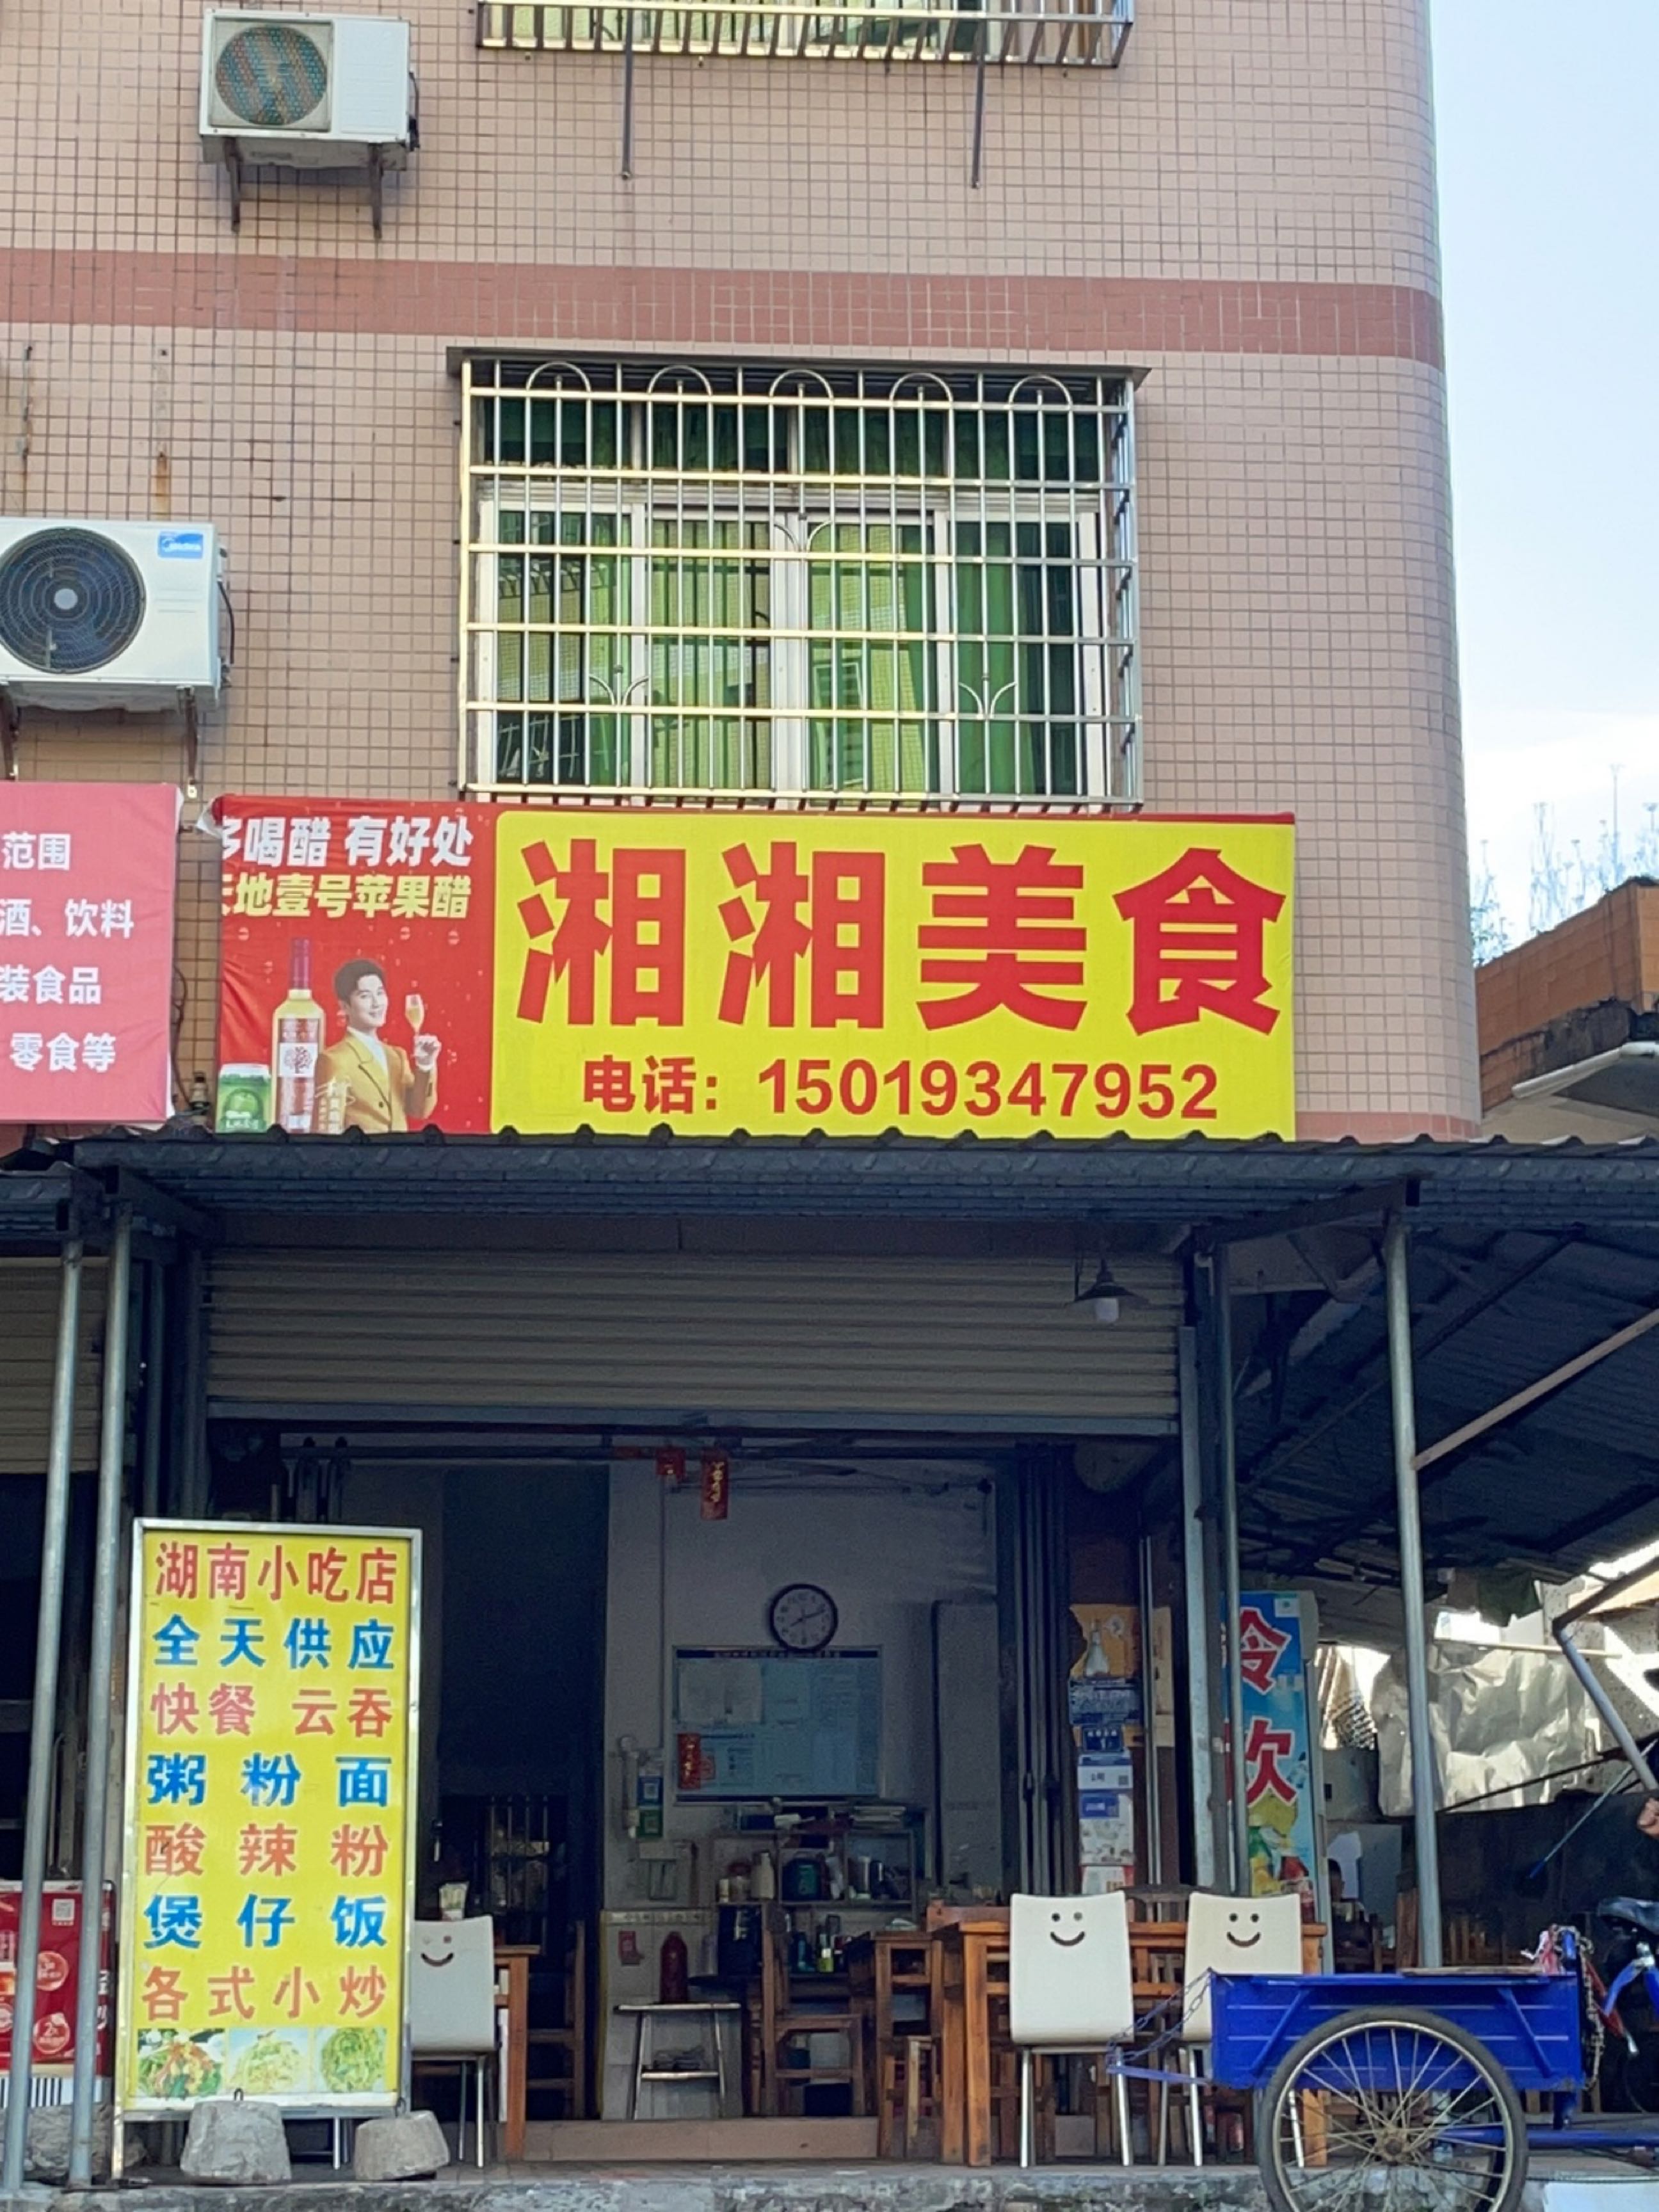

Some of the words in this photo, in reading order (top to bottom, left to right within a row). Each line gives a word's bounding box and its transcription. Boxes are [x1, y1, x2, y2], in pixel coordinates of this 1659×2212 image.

[1, 831, 71, 870] 范围
[344, 815, 474, 867] 有好处
[222, 872, 472, 919] 地壹号苹果醋
[517, 838, 1286, 1036] 湘湘美食
[0, 964, 102, 1004] 装食品
[10, 1032, 116, 1073] 零食等
[155, 1542, 397, 1604] 湖南小吃店
[152, 1614, 395, 1670] 全天供应
[141, 1965, 387, 2021] 各式小炒
